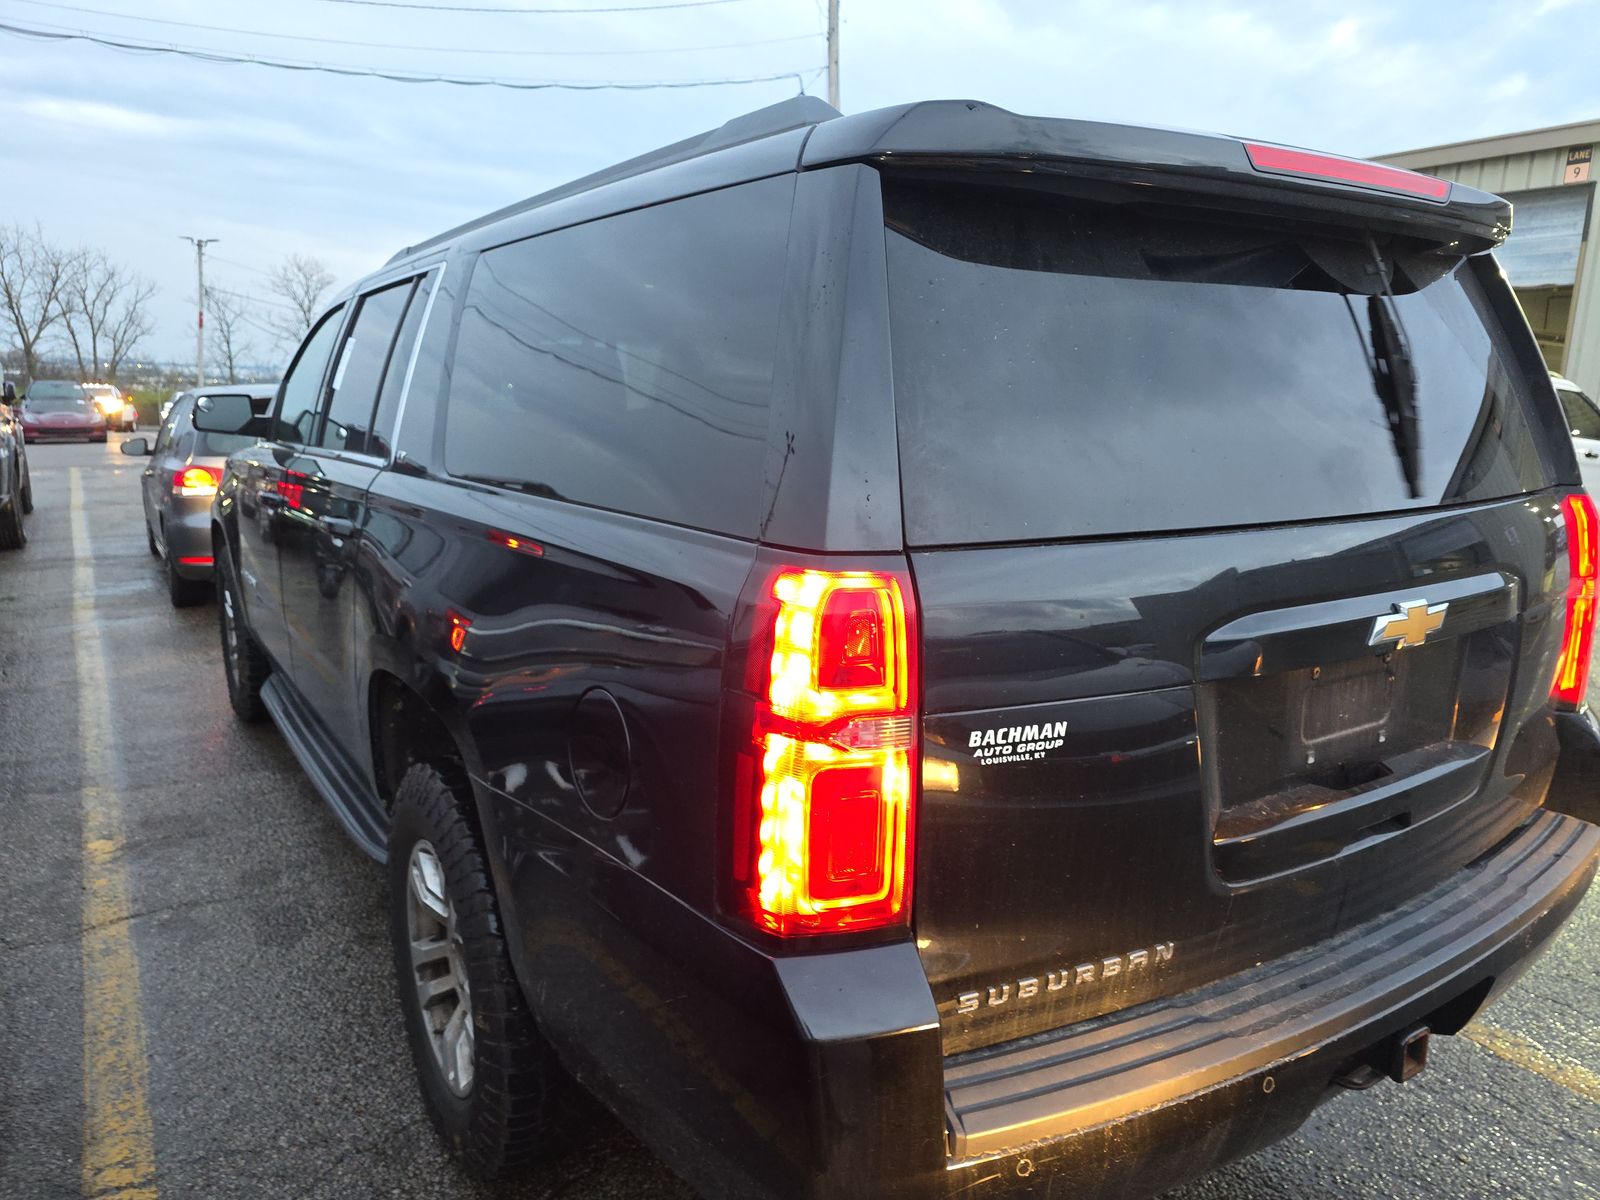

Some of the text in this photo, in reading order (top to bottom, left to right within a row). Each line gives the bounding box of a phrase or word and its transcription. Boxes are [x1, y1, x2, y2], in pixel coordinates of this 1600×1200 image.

[1569, 150, 1591, 161] LANE
[1573, 167, 1581, 178] 9
[968, 721, 1068, 747] BACHMAN
[973, 739, 1064, 758] AUTO GROUP
[981, 753, 1033, 765] LOUISVILLE,
[957, 940, 1175, 1014] SUBURBAN
